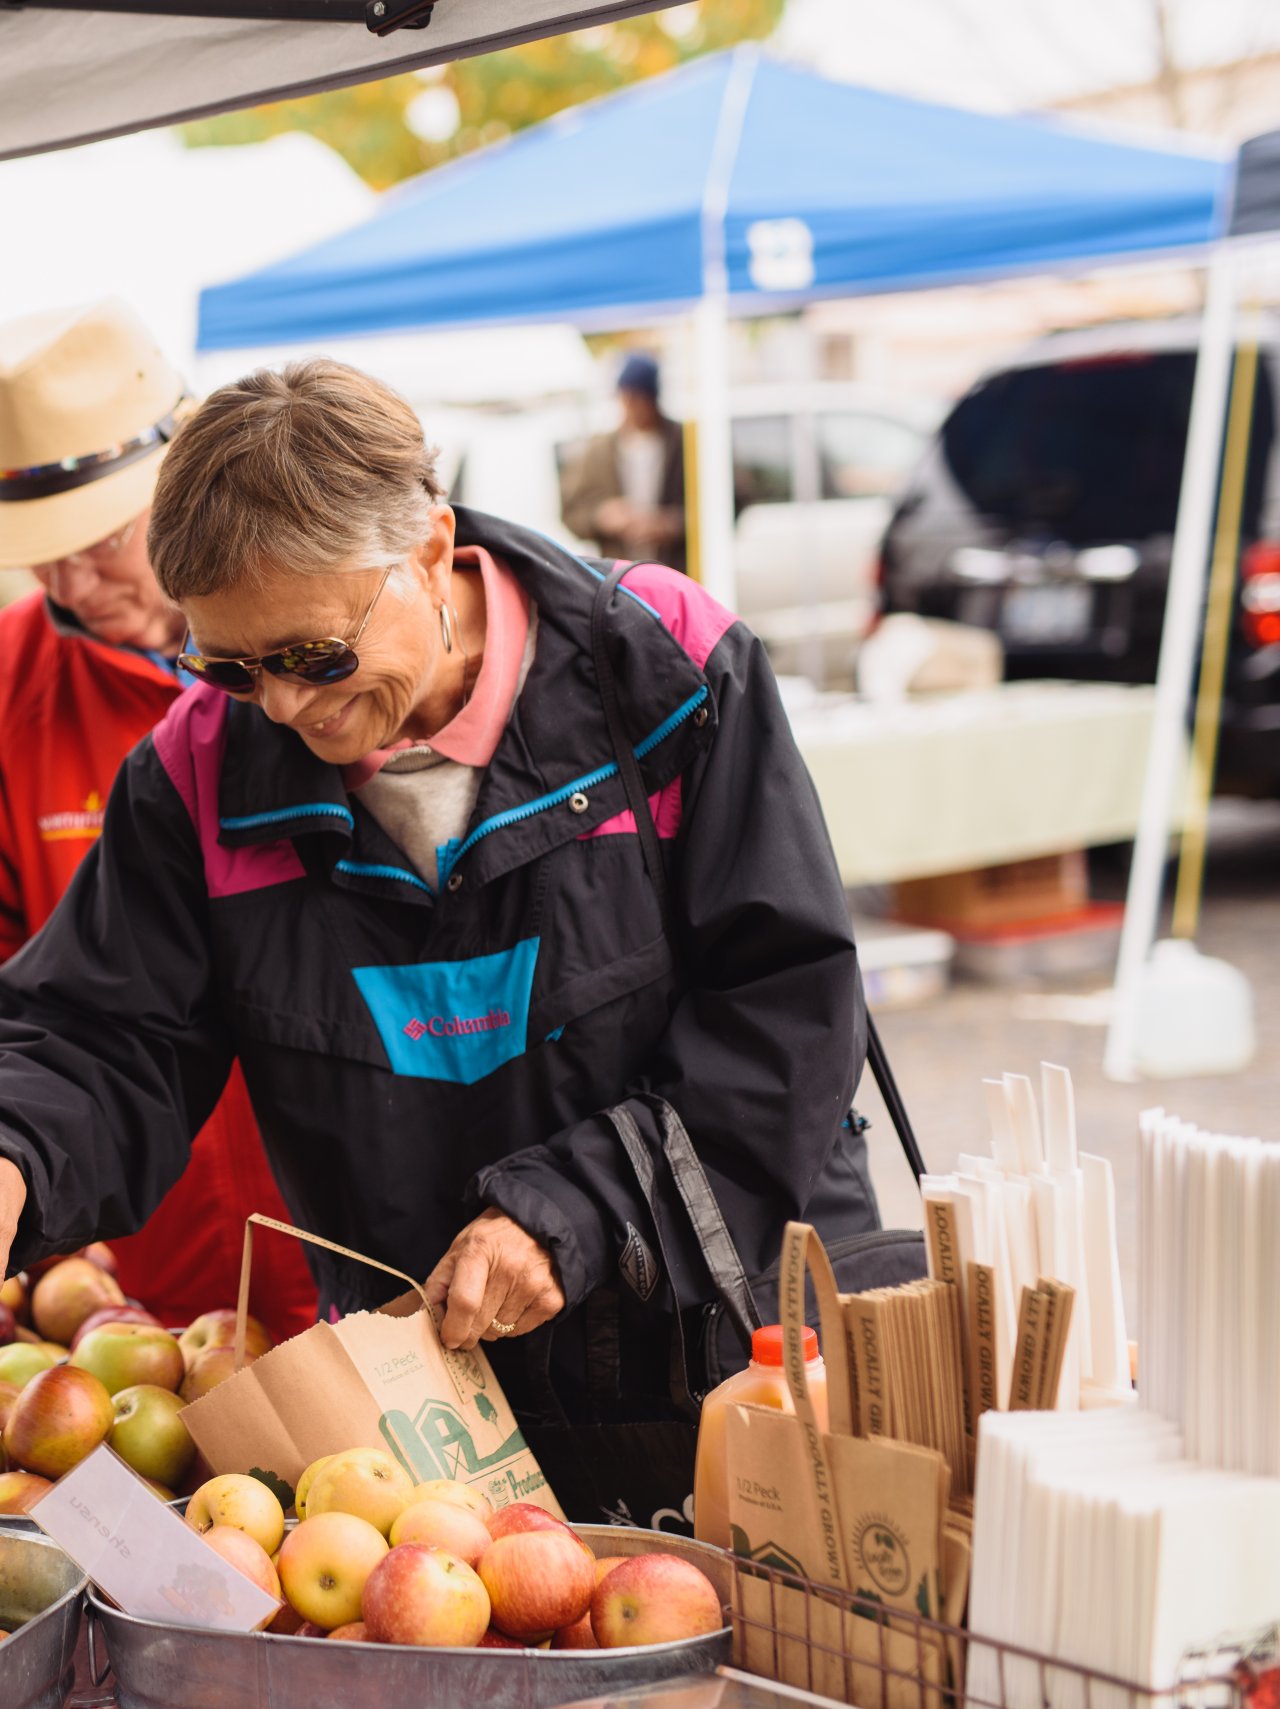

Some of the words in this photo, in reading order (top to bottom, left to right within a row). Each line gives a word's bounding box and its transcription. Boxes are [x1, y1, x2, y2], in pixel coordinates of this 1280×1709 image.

[427, 1008, 511, 1037] Columbia
[786, 1234, 802, 1322] LOCALLY
[975, 1265, 991, 1338] OCALLY
[391, 1350, 420, 1369] Peck
[787, 1327, 807, 1399] GROWN
[860, 1317, 882, 1400] LOCALLY
[753, 1482, 781, 1500] Peck
[804, 1422, 830, 1505] LOCALLY
[821, 1508, 841, 1580] GROWN
